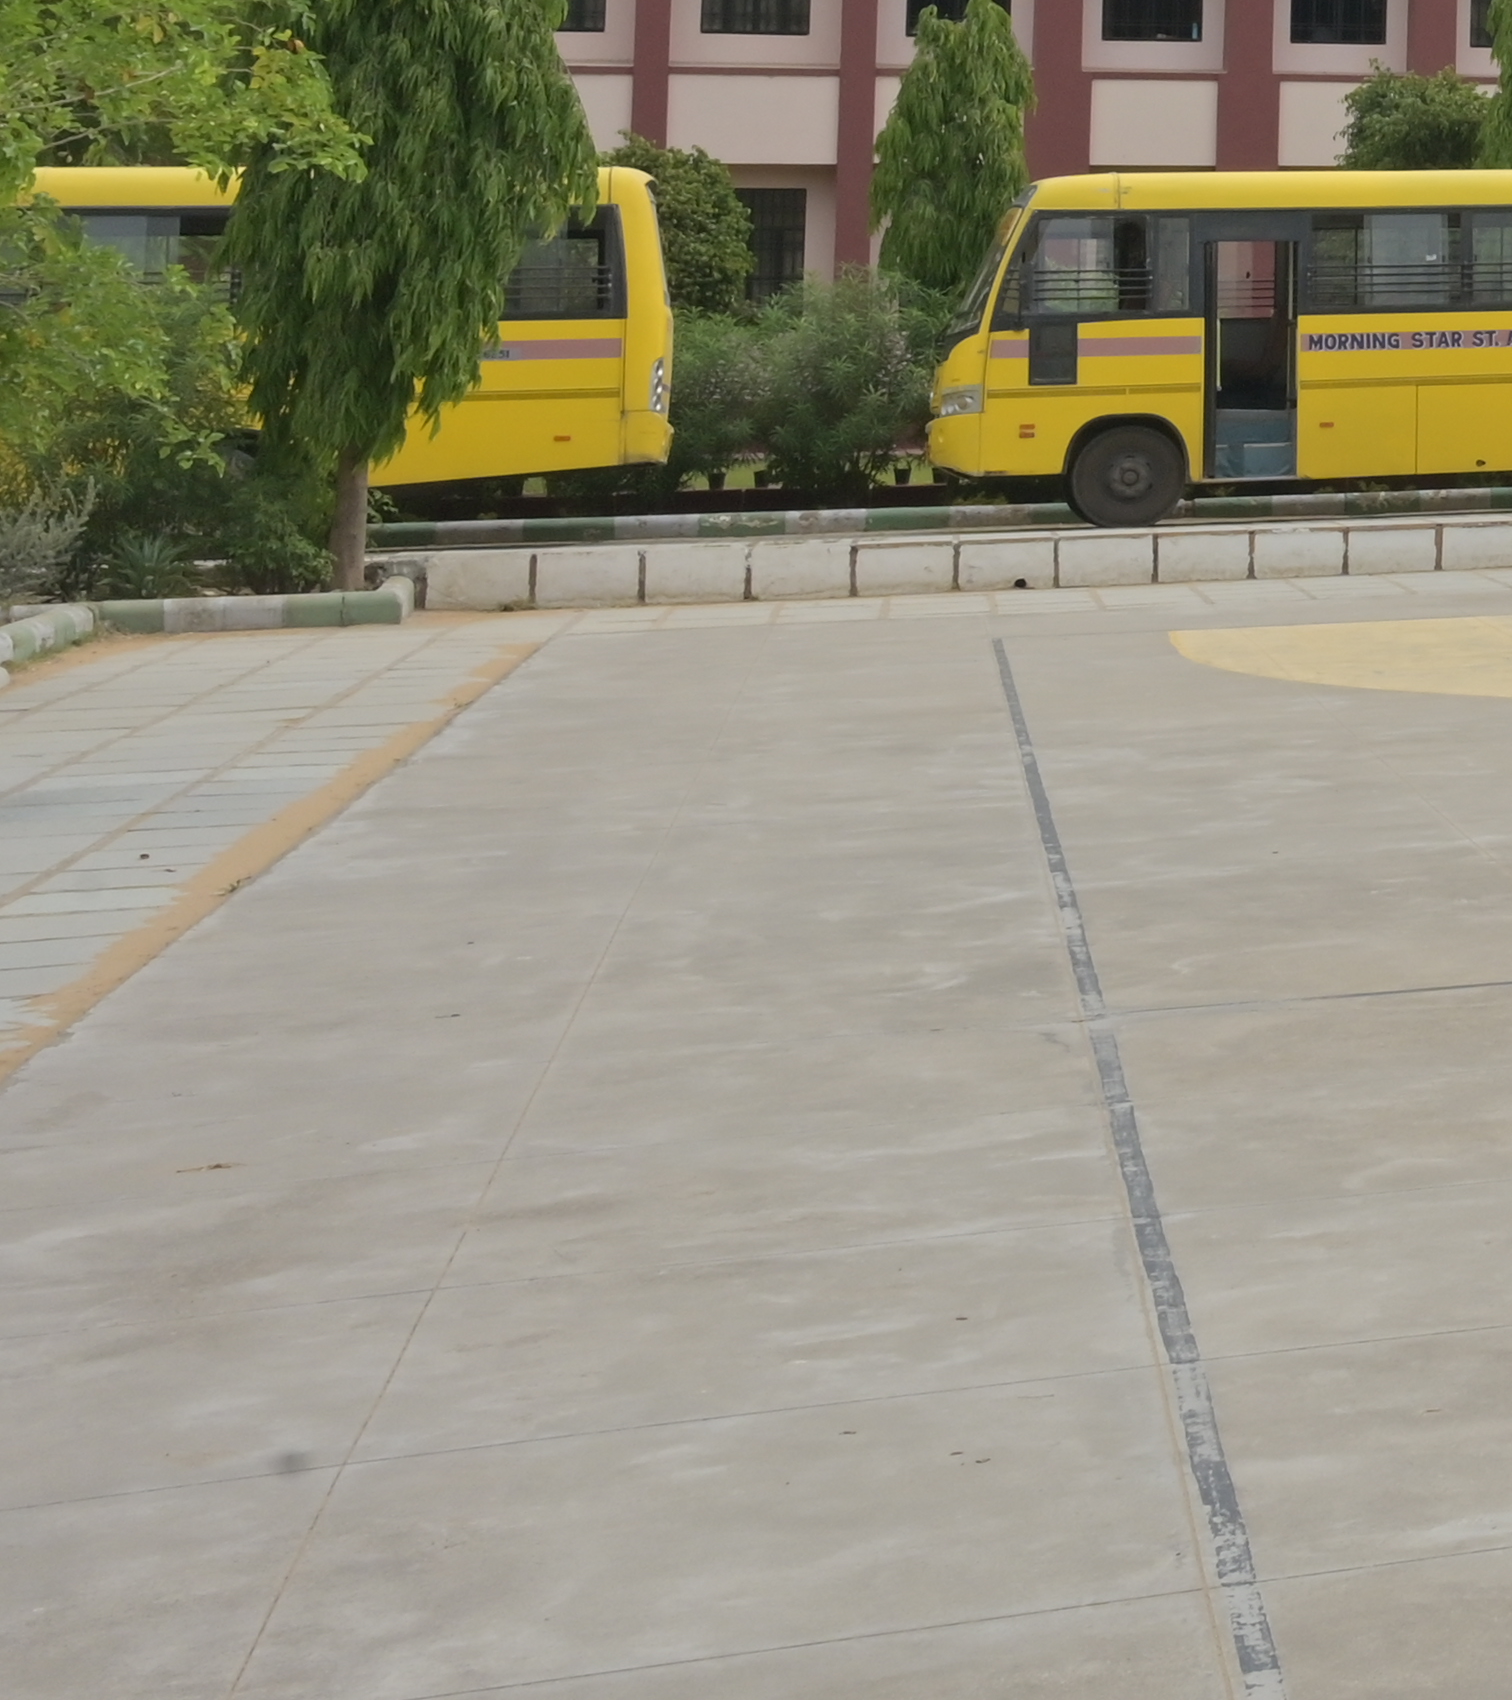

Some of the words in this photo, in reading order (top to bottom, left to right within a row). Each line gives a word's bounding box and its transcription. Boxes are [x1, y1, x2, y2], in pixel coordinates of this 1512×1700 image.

[1308, 333, 1400, 350] MORNING
[1411, 331, 1463, 348] STAR
[1472, 330, 1500, 347] ST.
